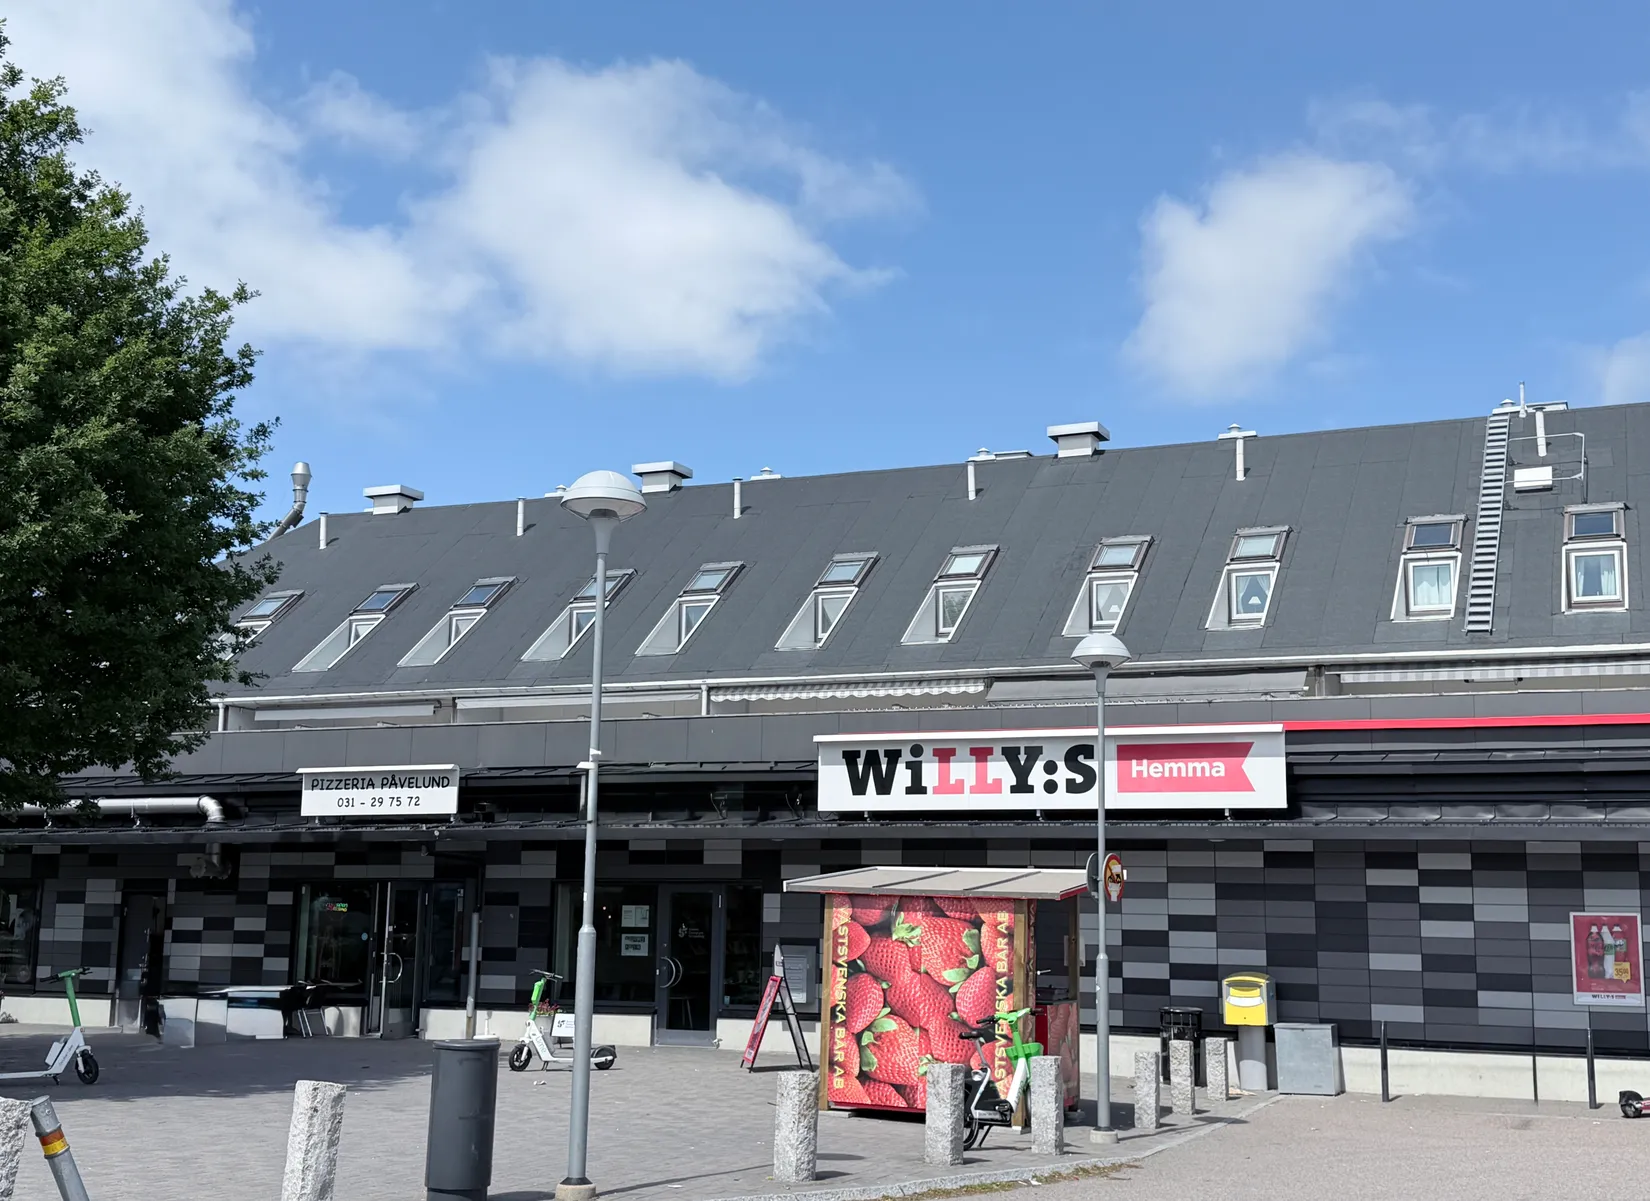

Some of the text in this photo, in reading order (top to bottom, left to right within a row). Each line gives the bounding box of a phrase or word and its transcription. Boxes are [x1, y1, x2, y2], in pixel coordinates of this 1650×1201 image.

[1131, 758, 1225, 779] Hemma
[311, 774, 450, 791] PIZZERIA PÅVELUND
[337, 796, 355, 808] 031
[370, 796, 384, 807] 29
[388, 796, 402, 807] 75
[406, 795, 421, 806] 72
[996, 937, 1009, 972] BAR
[833, 904, 851, 1089] VÄSTSVENSKA BAR AB
